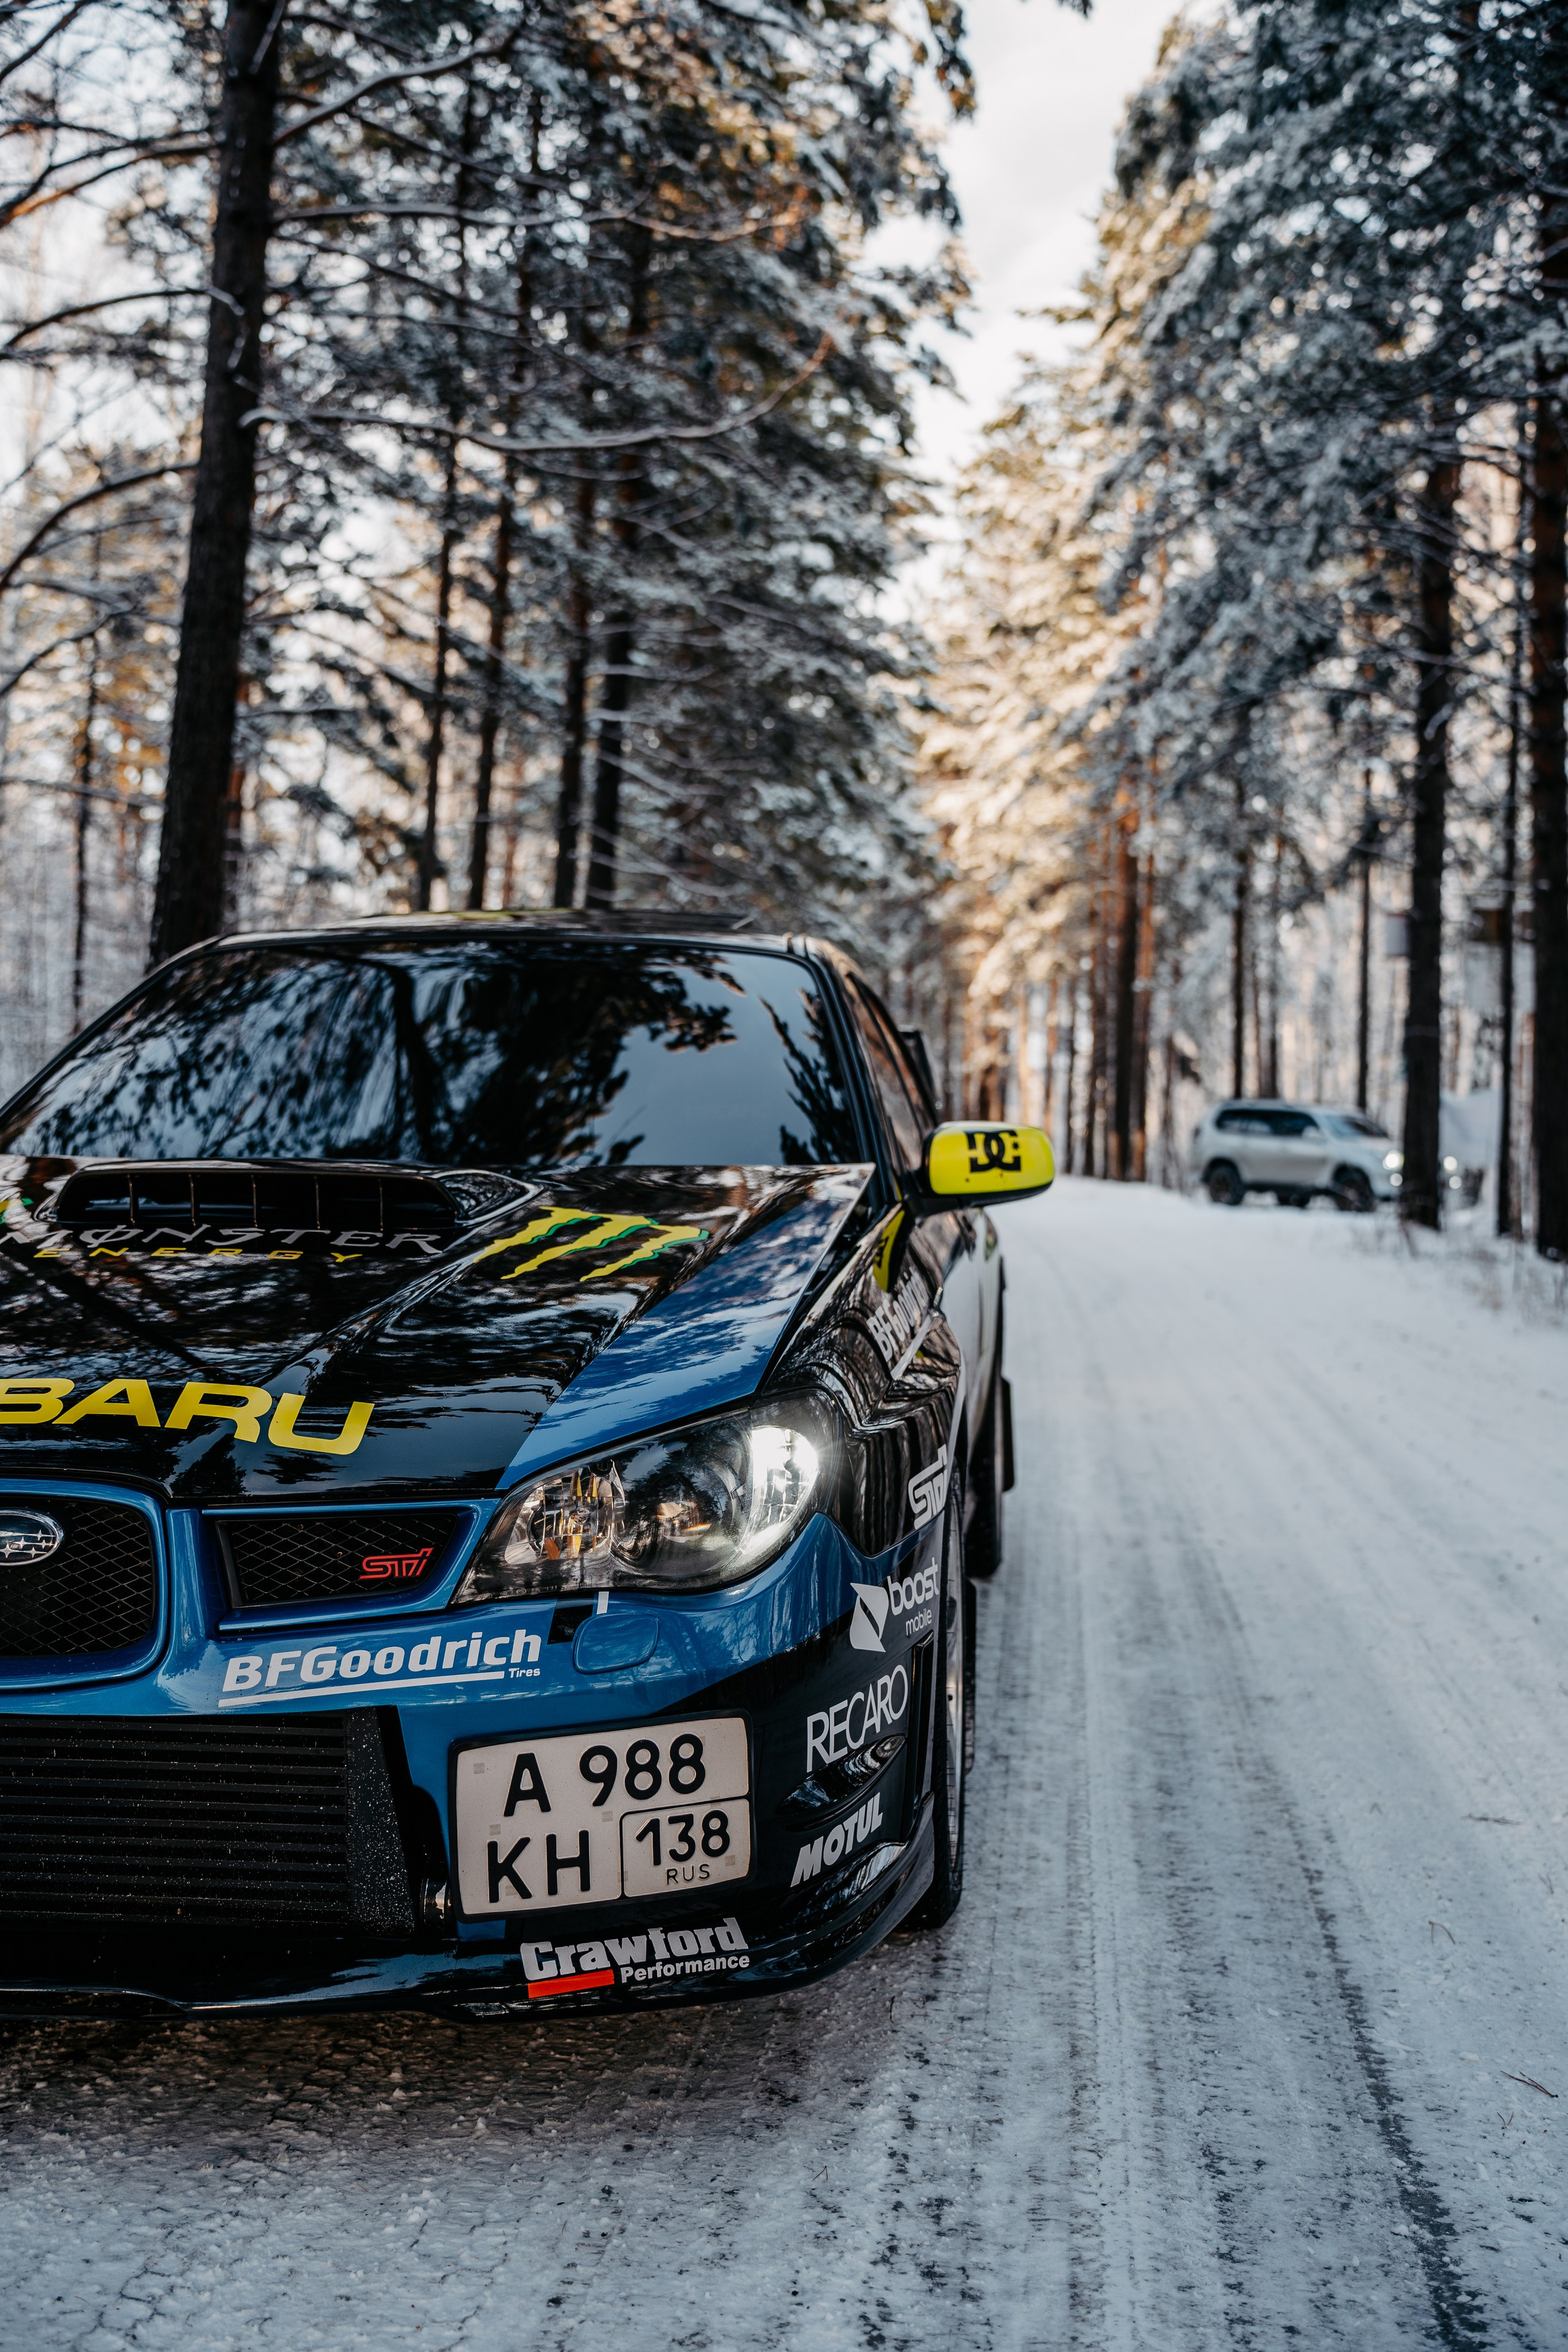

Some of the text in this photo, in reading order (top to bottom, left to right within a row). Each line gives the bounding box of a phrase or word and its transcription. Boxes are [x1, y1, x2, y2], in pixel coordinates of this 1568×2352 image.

[34, 1247, 363, 1262] ENERGY
[887, 1557, 940, 1616] boost
[905, 1608, 932, 1636] mobile
[222, 1629, 541, 1692] BFGoodrich
[508, 1668, 541, 1679] Tires
[807, 1664, 908, 1773] RECARO
[503, 1733, 706, 1817] A 988
[488, 1830, 591, 1903] KH
[636, 1809, 730, 1866] 138
[790, 1792, 883, 1888] MOTUL
[667, 1864, 710, 1885] RUS
[519, 1917, 749, 1981] Crawford
[620, 1954, 750, 1983] Performance
